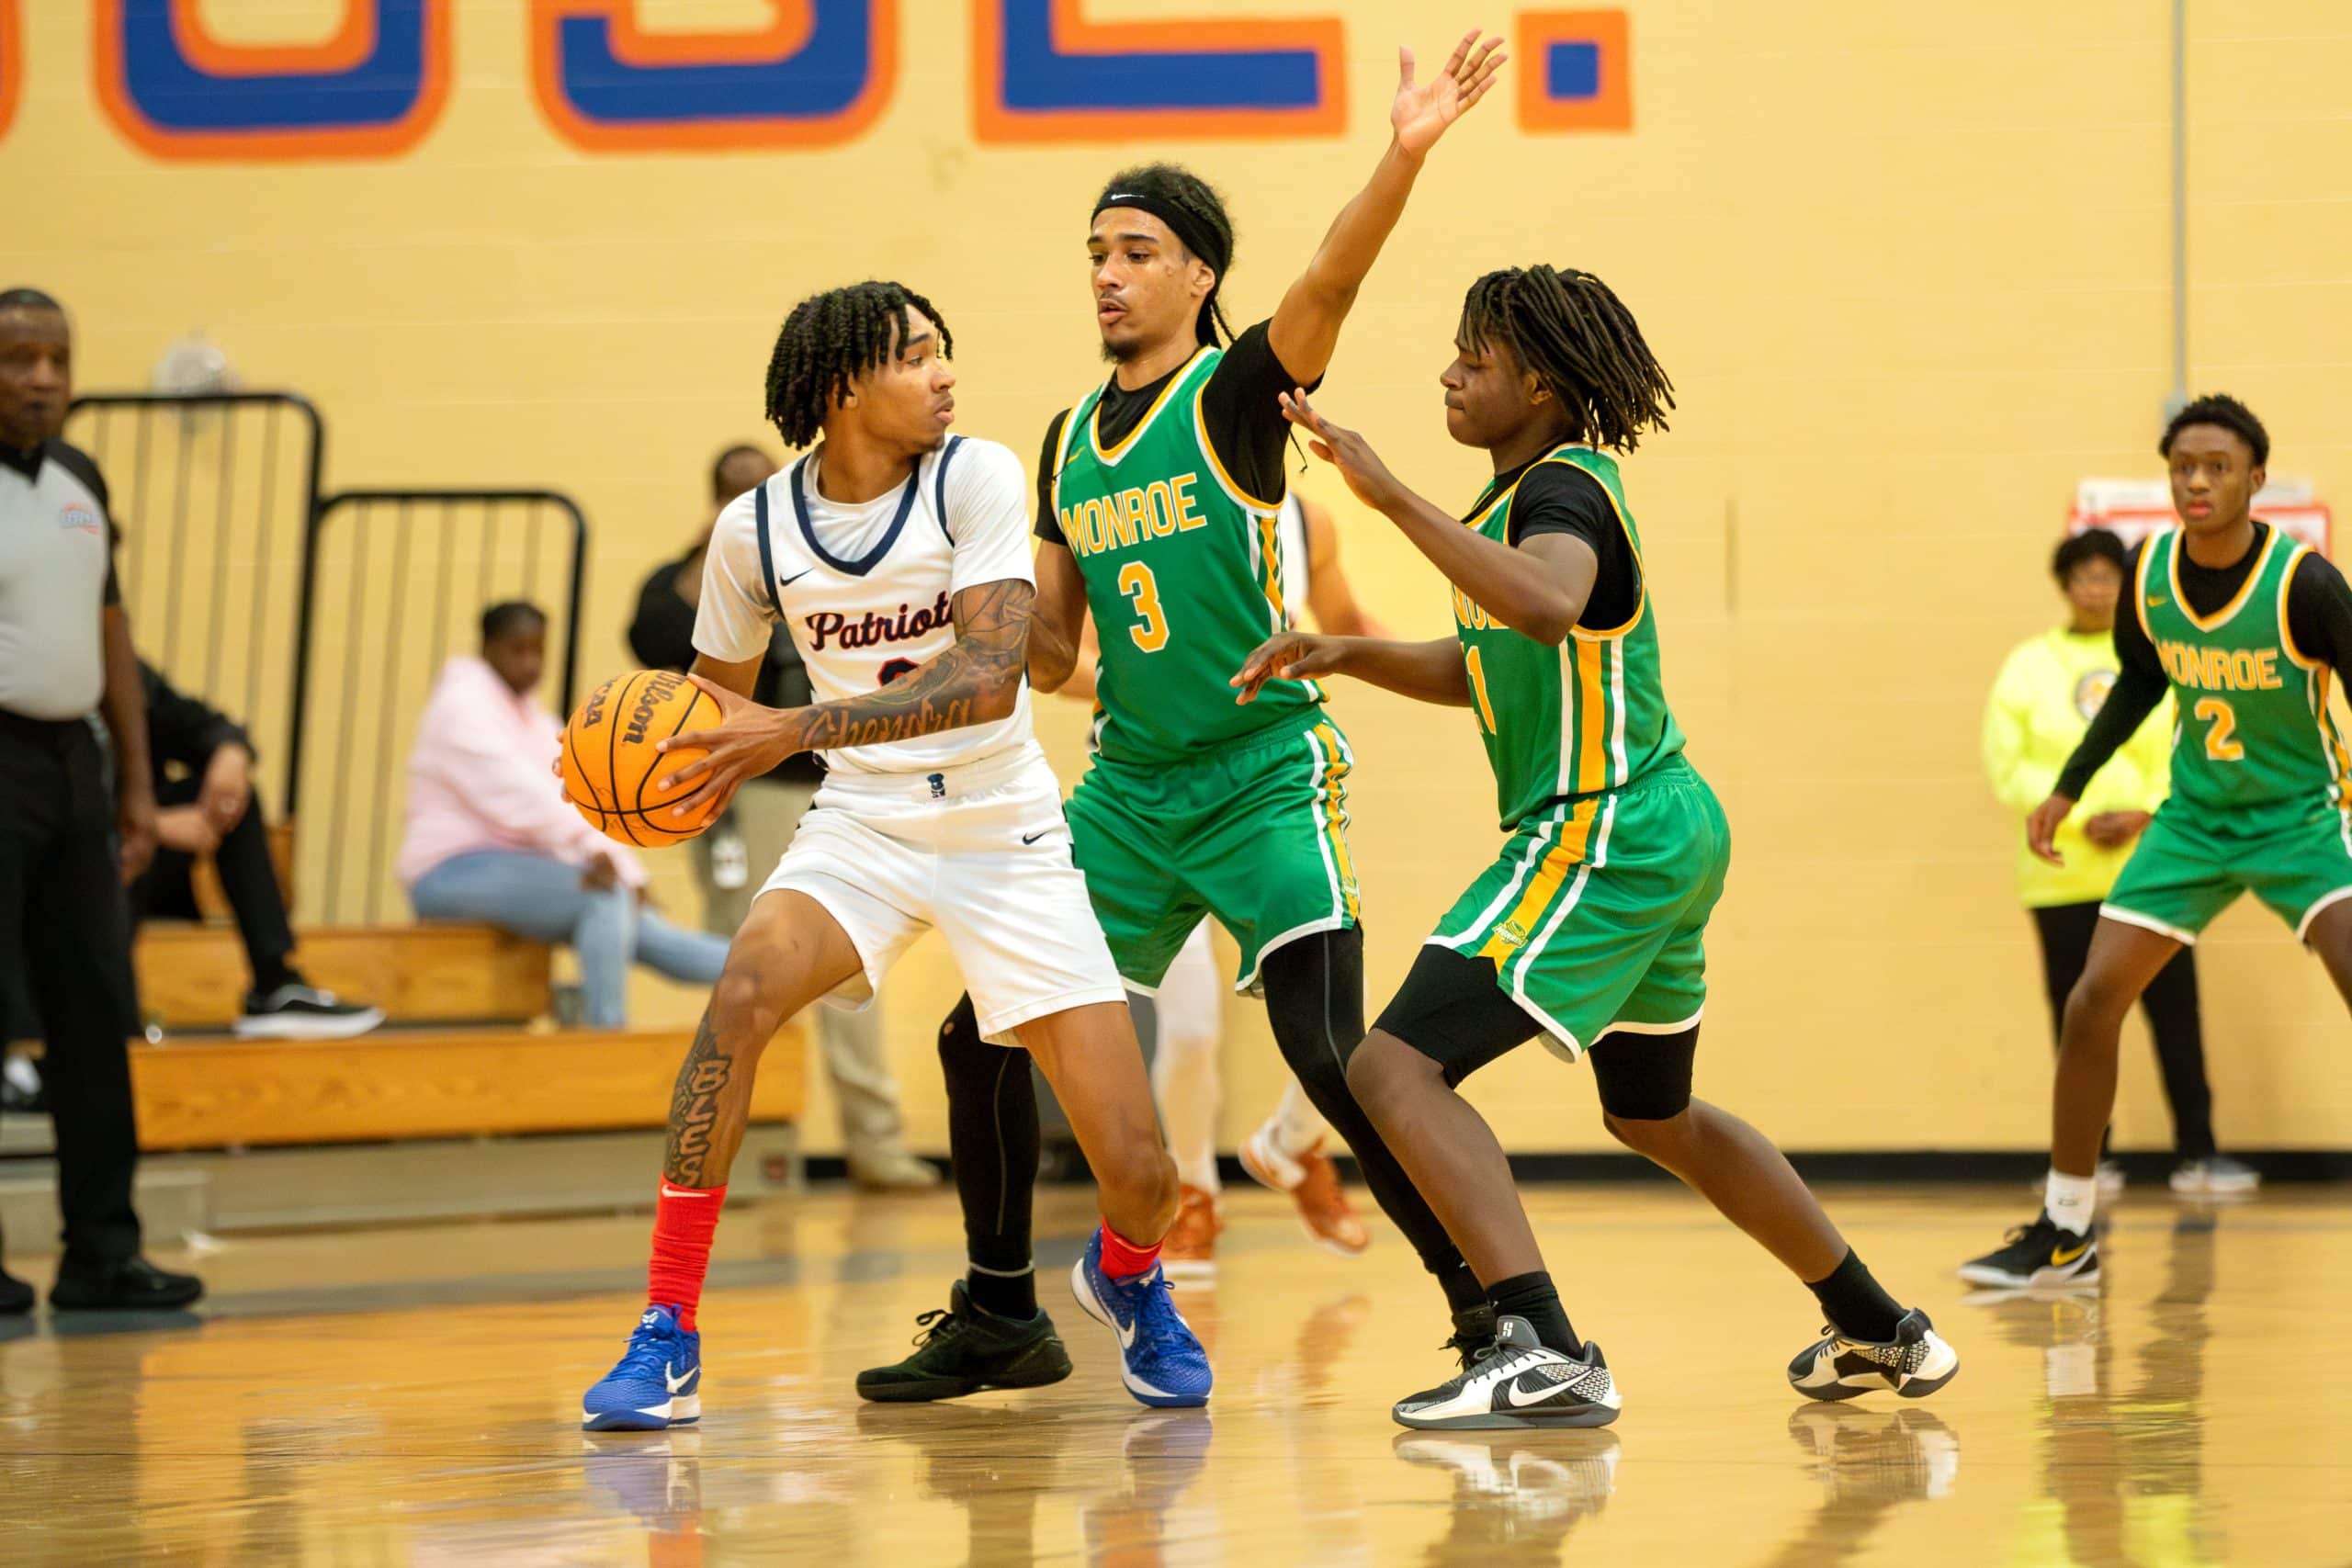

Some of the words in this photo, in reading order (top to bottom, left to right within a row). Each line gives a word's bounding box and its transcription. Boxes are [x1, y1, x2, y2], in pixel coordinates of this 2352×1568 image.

[1061, 472, 1207, 558] MONROE
[1118, 560, 1170, 653] 3
[2195, 697, 2244, 761] 2
